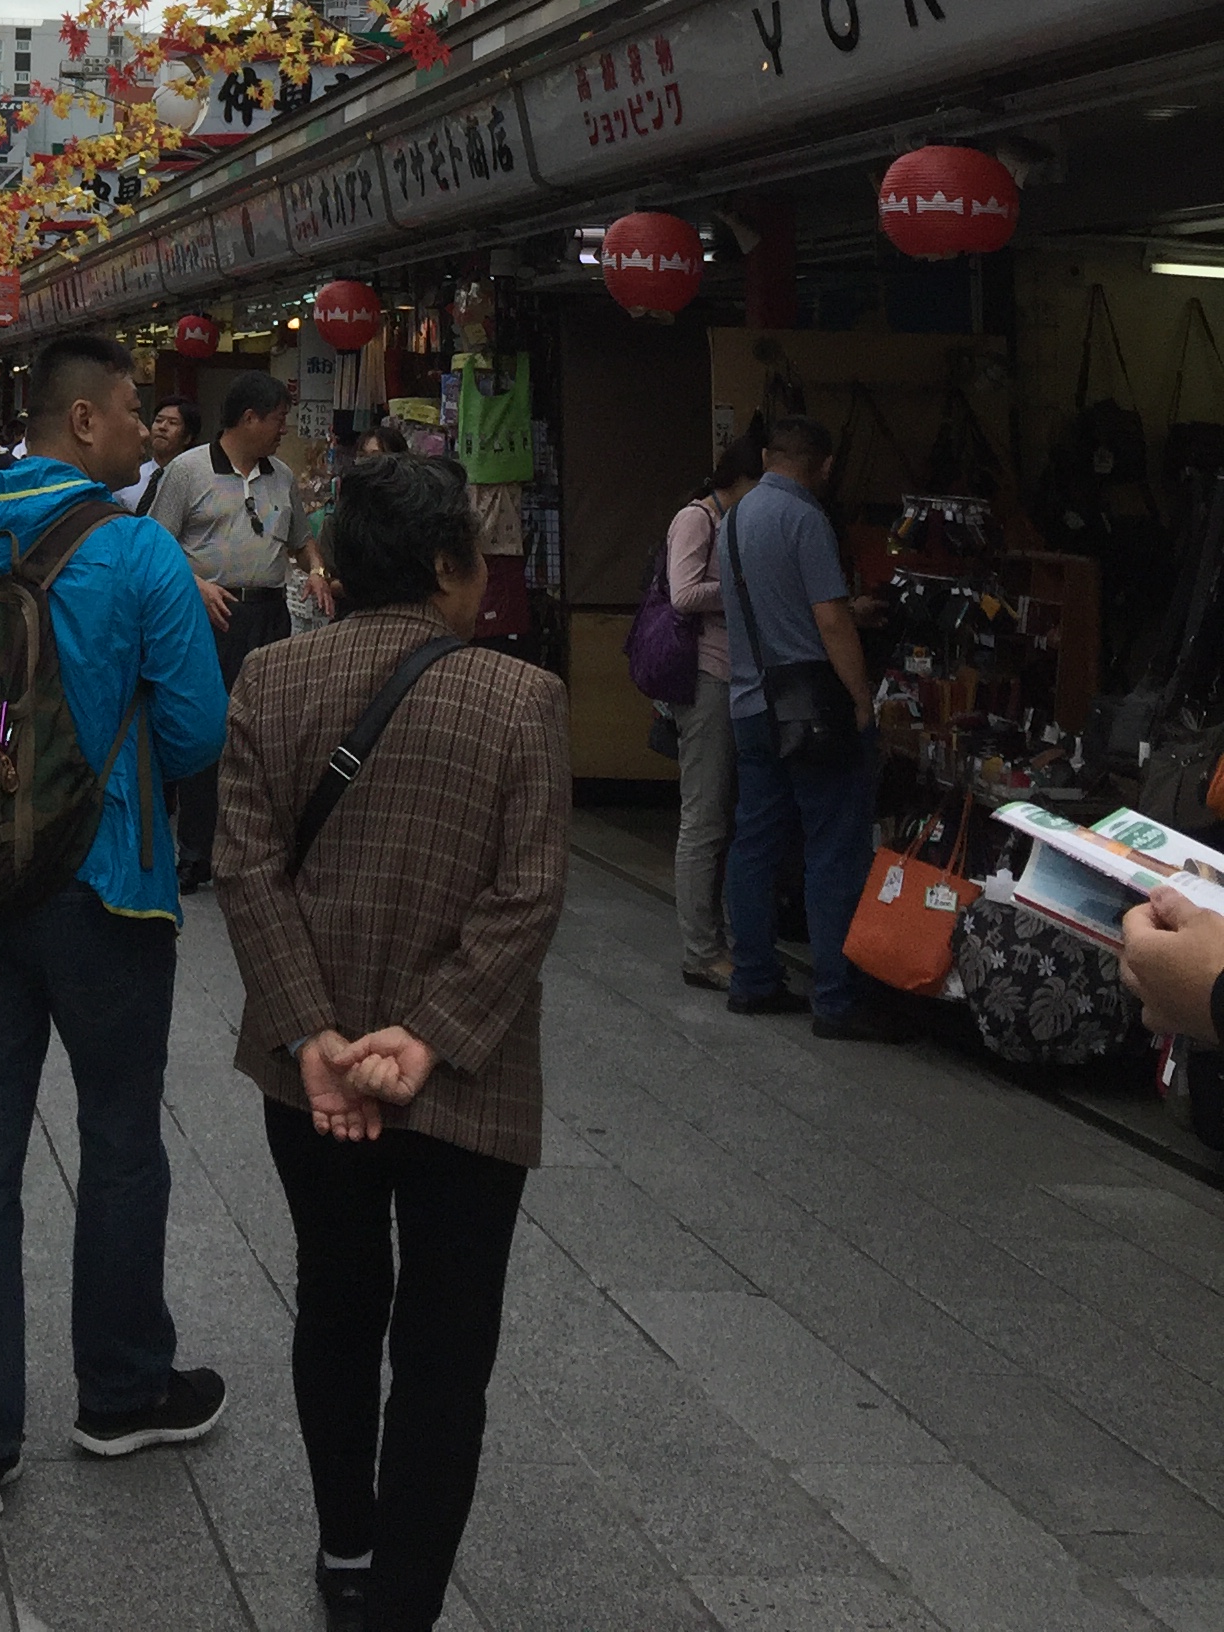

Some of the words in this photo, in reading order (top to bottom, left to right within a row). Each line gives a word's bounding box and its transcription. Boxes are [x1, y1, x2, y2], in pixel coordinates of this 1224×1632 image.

[393, 106, 514, 201] マサモト商店
